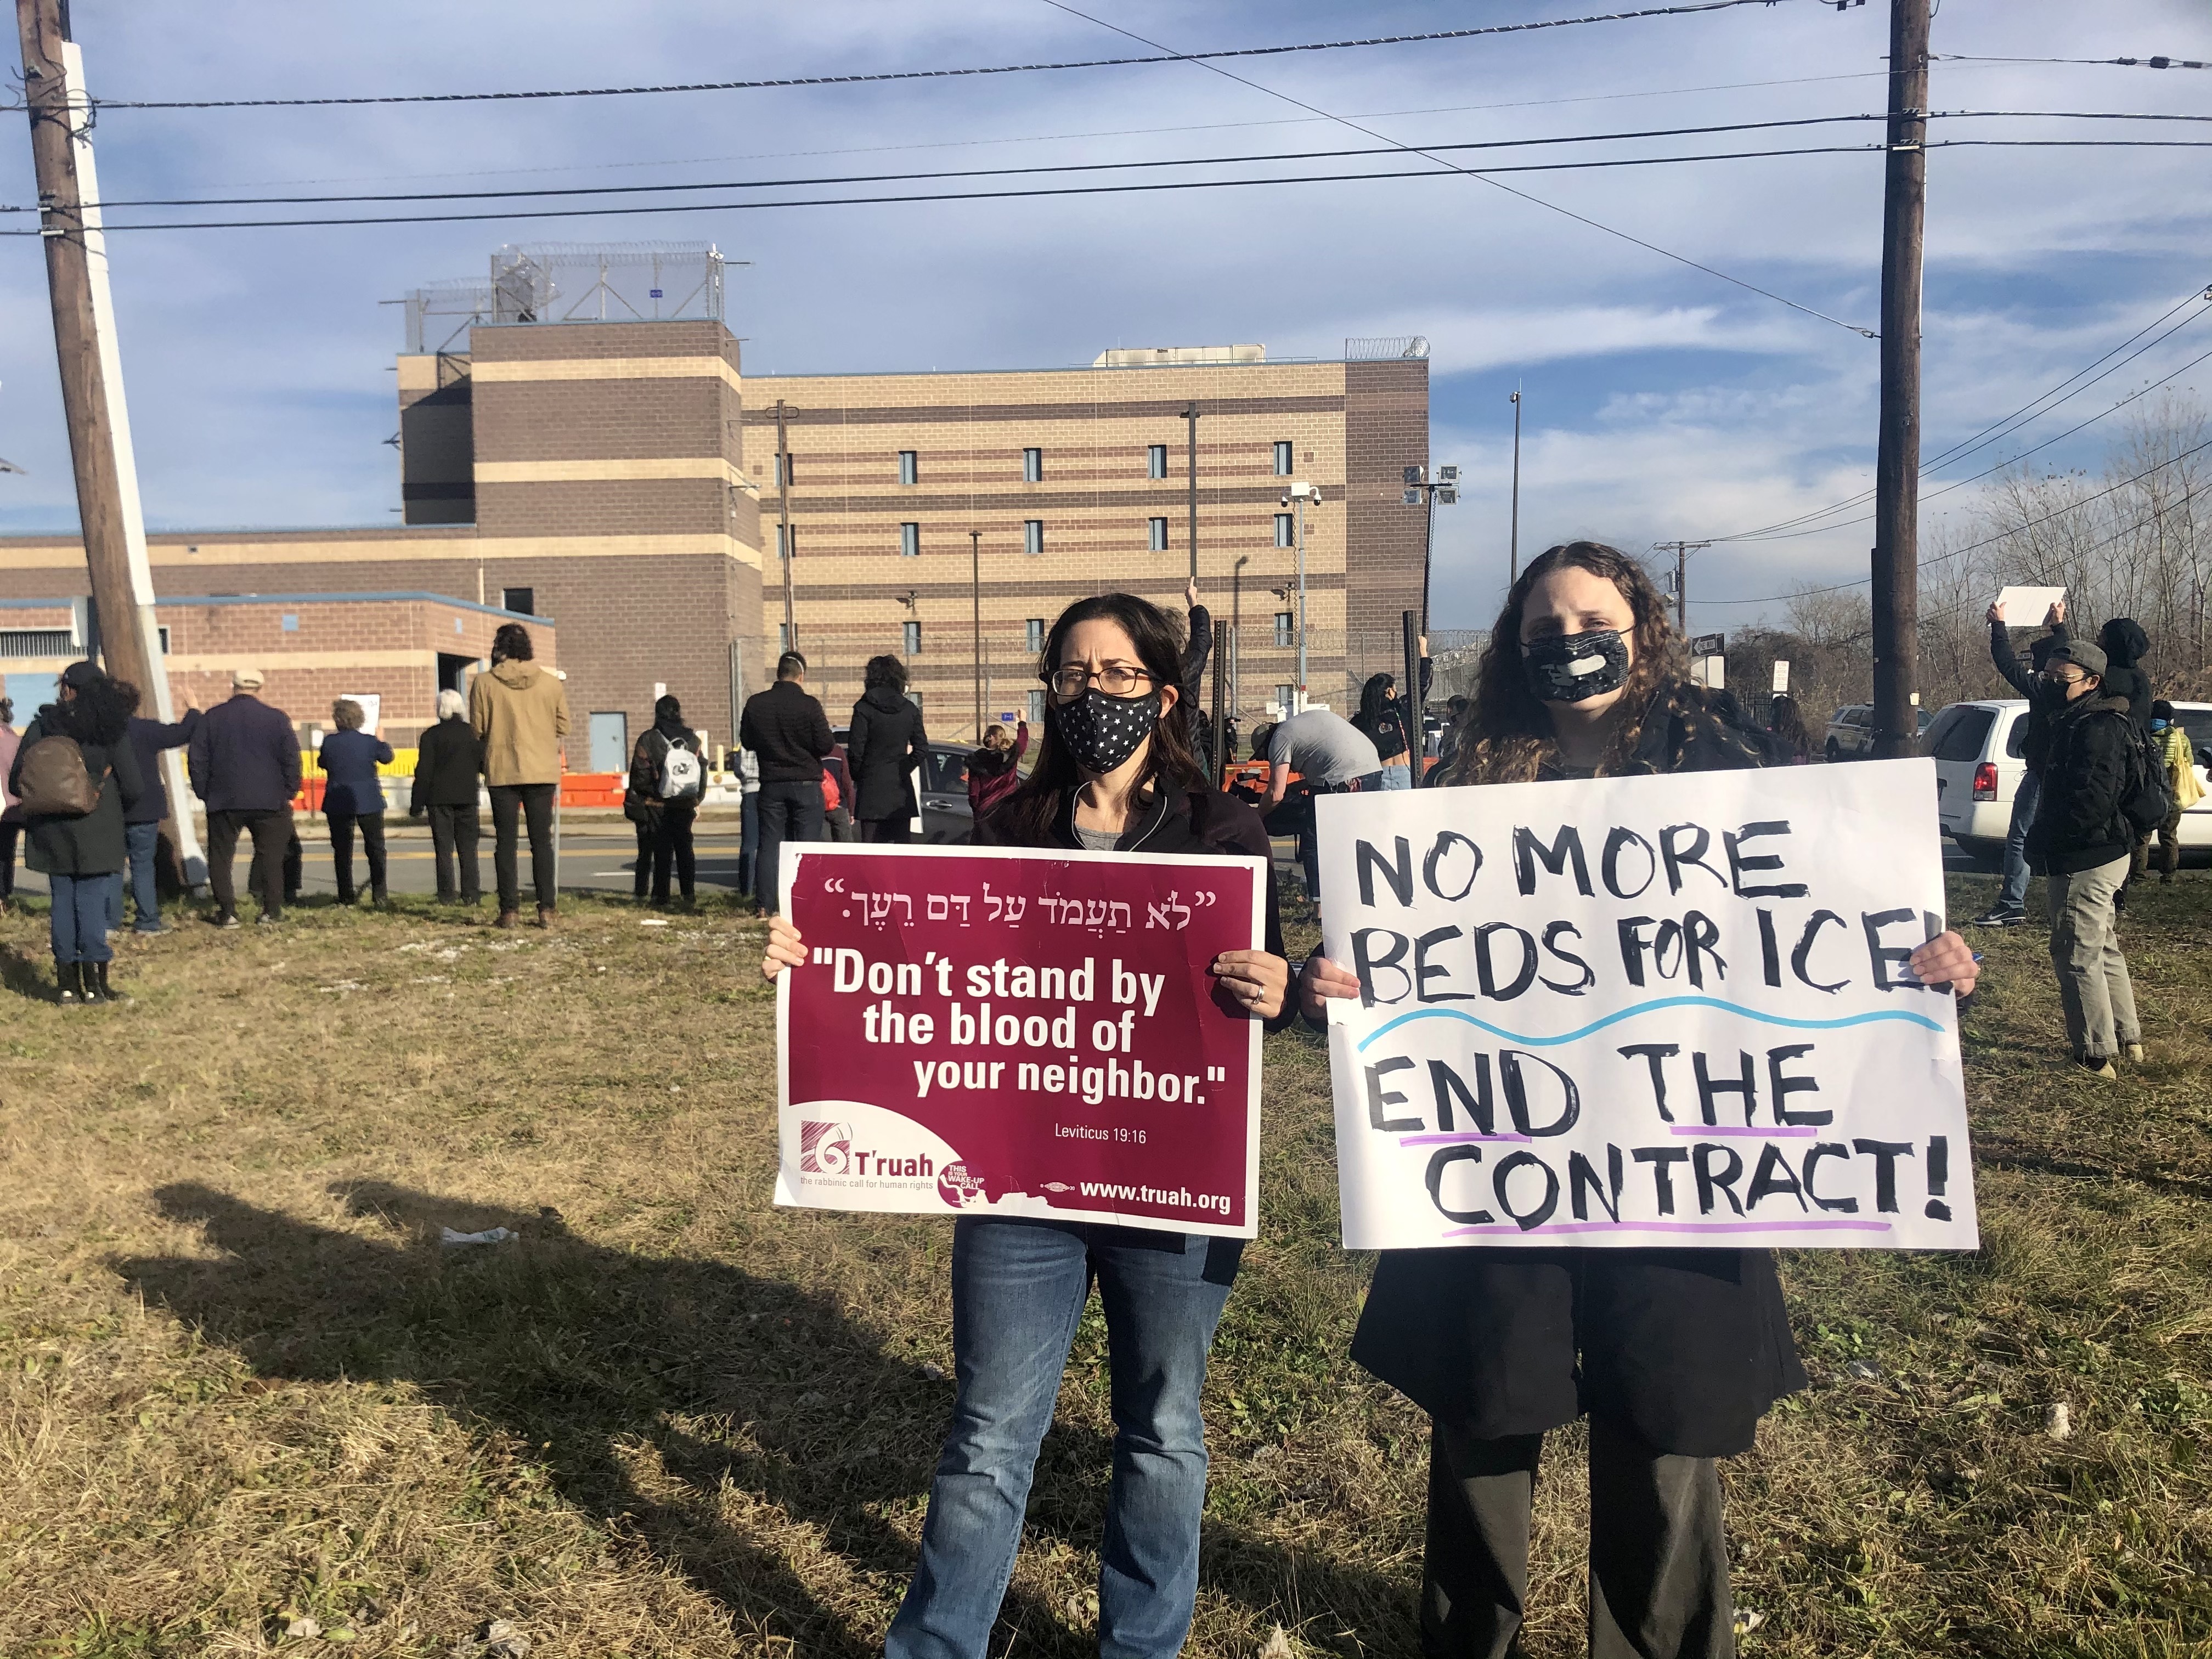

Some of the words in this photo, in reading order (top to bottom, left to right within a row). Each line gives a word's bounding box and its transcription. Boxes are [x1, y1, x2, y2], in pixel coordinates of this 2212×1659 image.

[1356, 831, 1483, 907] NO
[1513, 821, 1810, 899] MORE
[1350, 921, 1595, 1008] BEDS
[1618, 910, 1727, 990] FOR
[966, 957, 1094, 1001] stand
[1112, 959, 1165, 1017] by
[863, 1000, 934, 1045] the
[951, 1002, 1076, 1049] blood
[1092, 1010, 1135, 1052] of
[913, 1060, 1006, 1098] your
[1018, 1056, 1225, 1104] neighbor."
[1363, 1049, 1580, 1137] END
[1616, 1043, 1833, 1127] THE
[1055, 1123, 1109, 1141] Leviticus
[1113, 1127, 1146, 1144] 19:16
[800, 1176, 812, 1184] the
[815, 1177, 847, 1187] rabbinic
[850, 1179, 864, 1187] call
[866, 1180, 877, 1188] for
[879, 1180, 907, 1189] human
[910, 1181, 933, 1190] rights
[948, 1175, 985, 1184] WAKE-UP
[1080, 1182, 1231, 1215] www.truah.org
[1425, 1134, 1952, 1232] CONTRACT!
